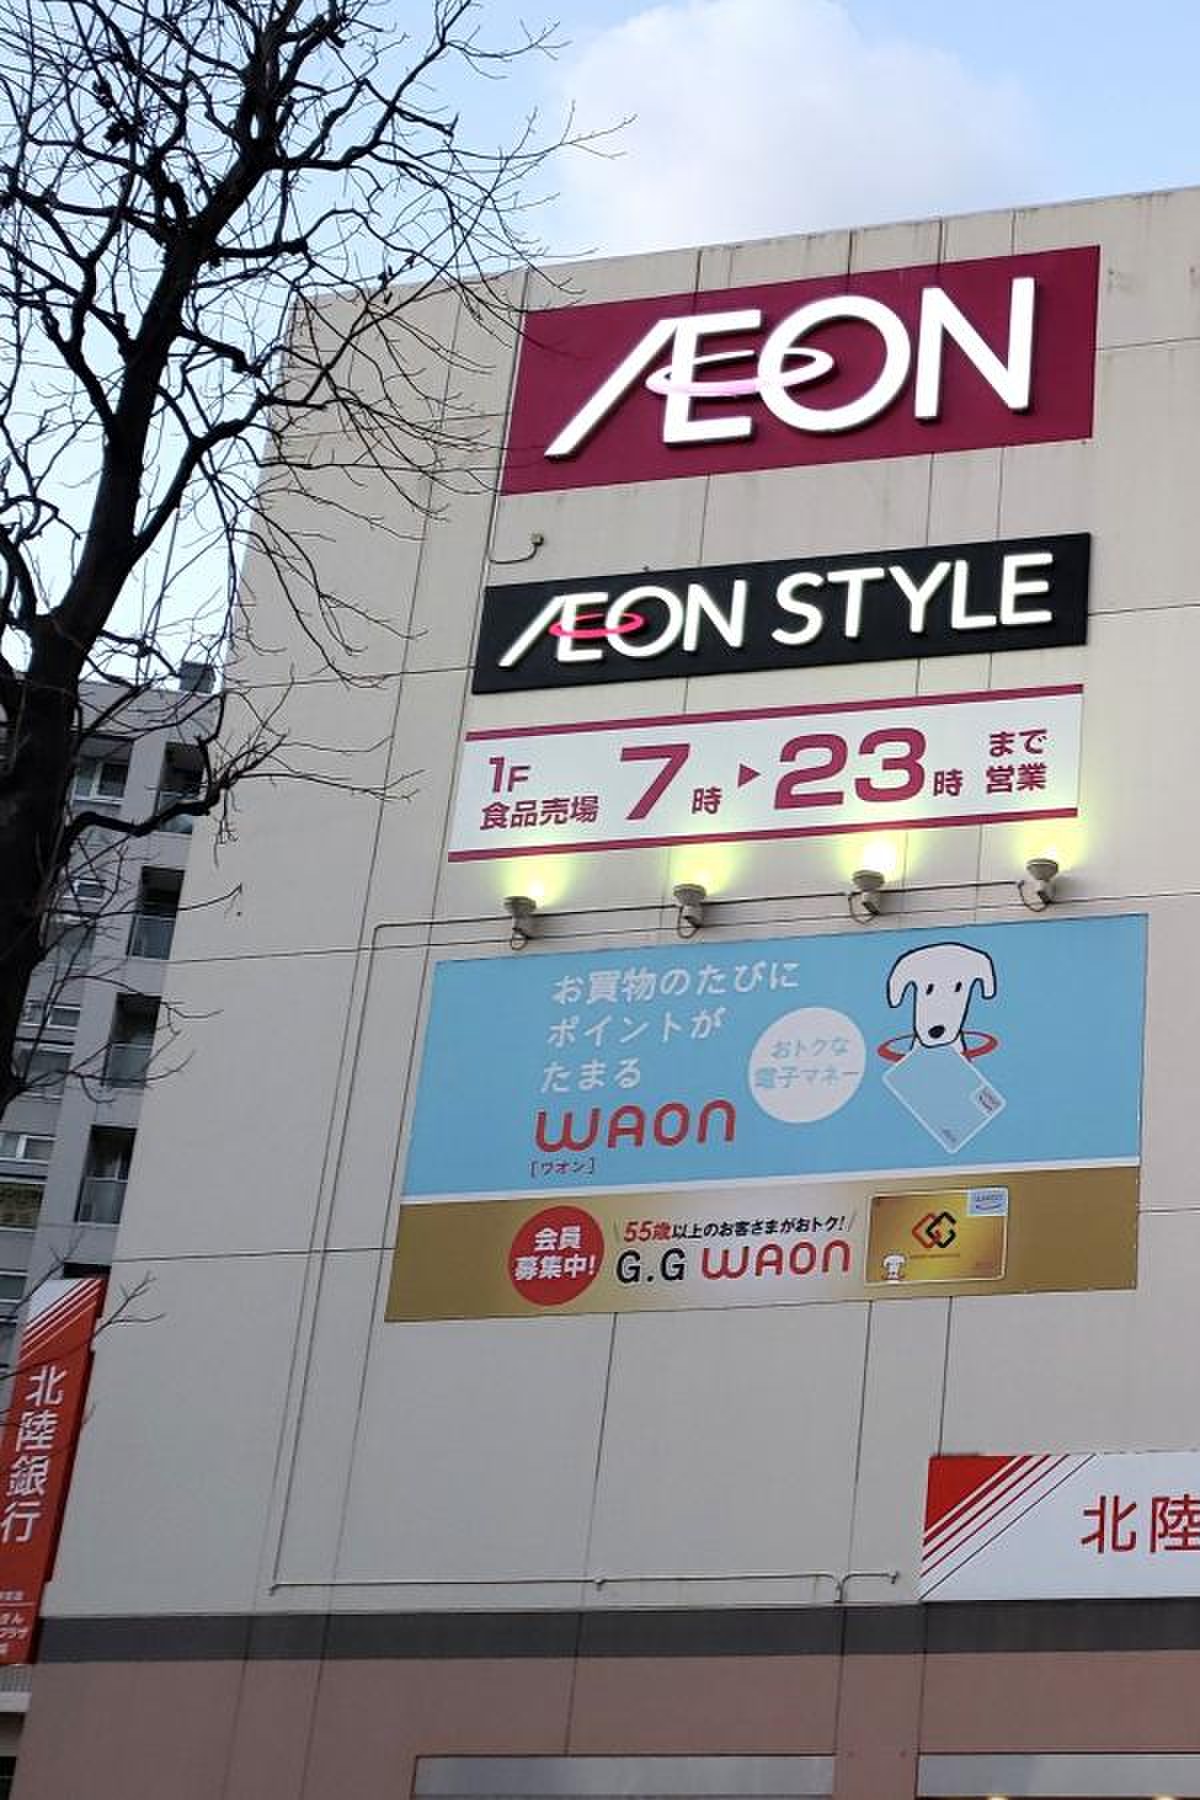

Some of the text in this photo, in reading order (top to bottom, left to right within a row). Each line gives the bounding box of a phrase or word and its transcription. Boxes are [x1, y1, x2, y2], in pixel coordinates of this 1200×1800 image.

[771, 552, 1054, 647] STYLE
[988, 729, 1047, 757] まで
[488, 757, 531, 794] 1F
[985, 762, 1048, 795] 営業
[479, 795, 599, 831] 食品売場
[553, 960, 800, 1006] お買物のたびに
[546, 1006, 727, 1048] ポイントが
[540, 1057, 642, 1094] たまる
[533, 1225, 582, 1252] 会員
[616, 1247, 686, 1285] G.G
[0, 1364, 68, 1544] 北陸銀行
